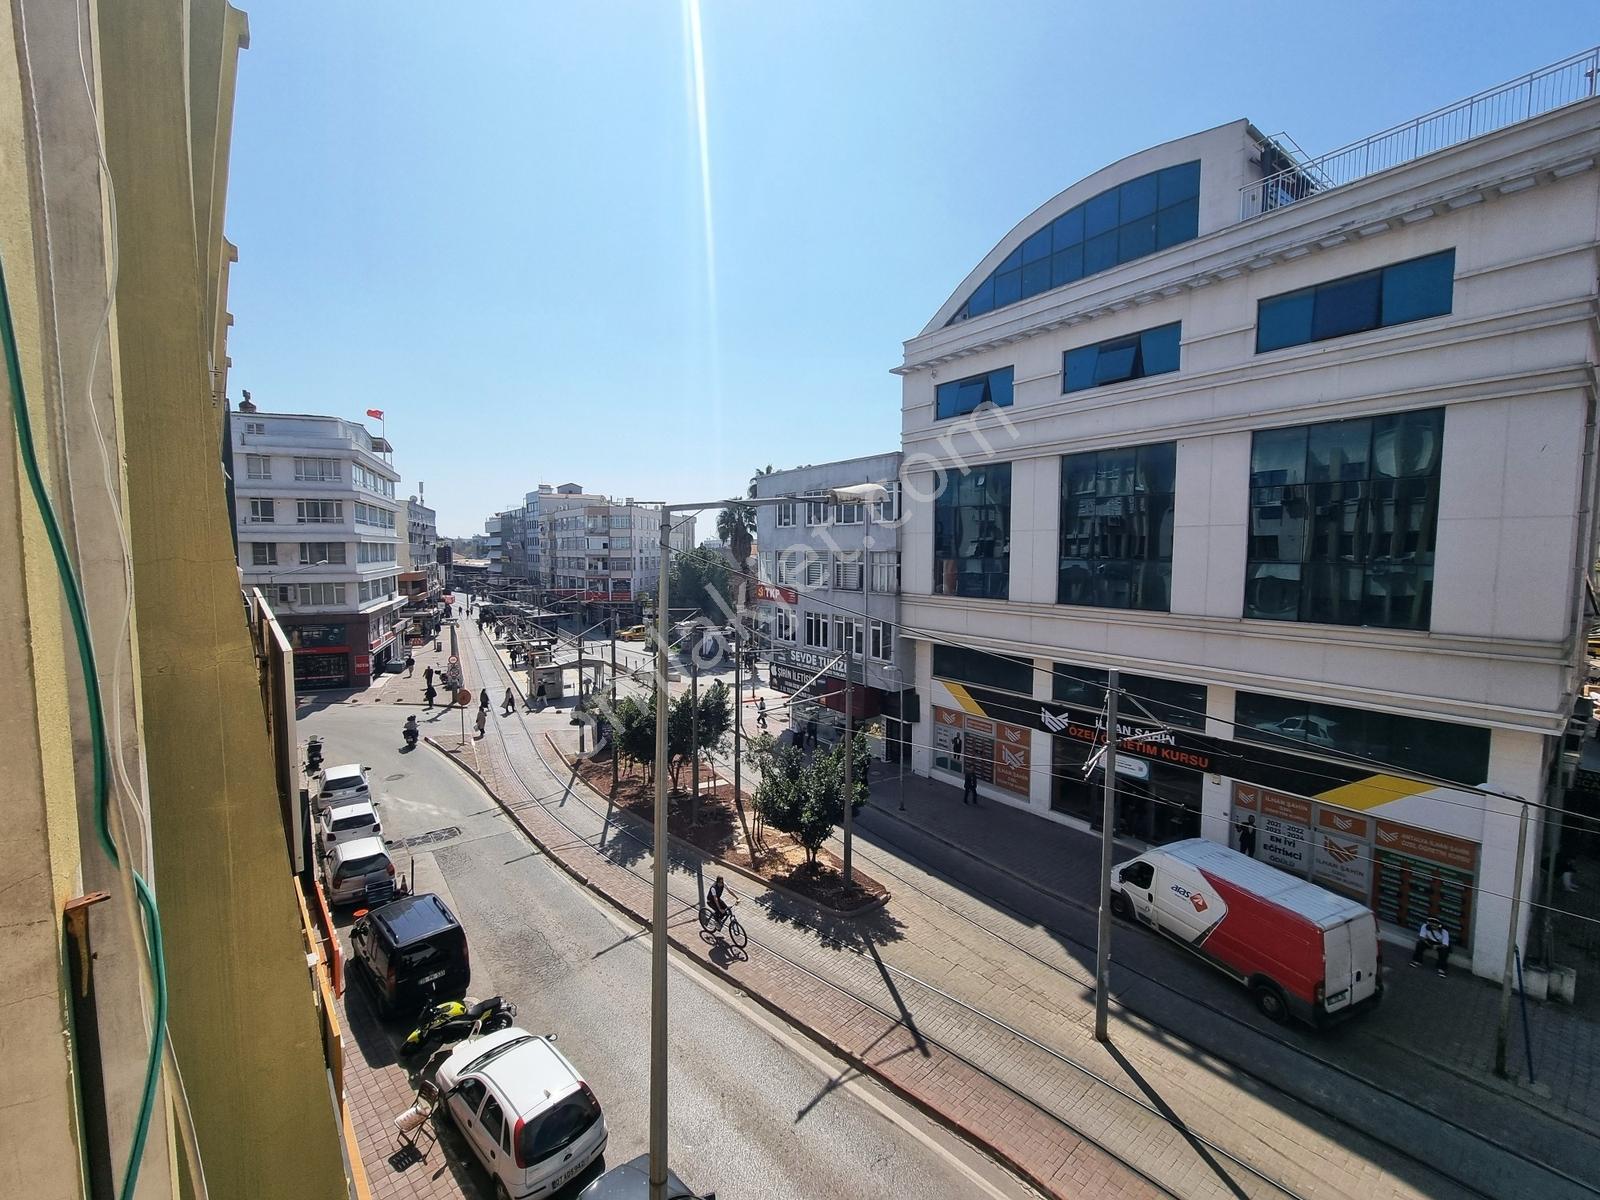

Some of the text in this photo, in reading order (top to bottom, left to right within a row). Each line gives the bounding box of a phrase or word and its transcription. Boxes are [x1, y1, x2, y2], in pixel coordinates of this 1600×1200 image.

[790, 650, 817, 666] SEVDE
[1095, 716, 1131, 736] İLAN
[1161, 747, 1209, 768] KURSU
[1266, 819, 1282, 828] 2021
[1287, 825, 1304, 834] 2022
[1270, 835, 1282, 843] EN
[1263, 843, 1302, 860] EĞİTİMCİ
[1170, 884, 1192, 898] aras
